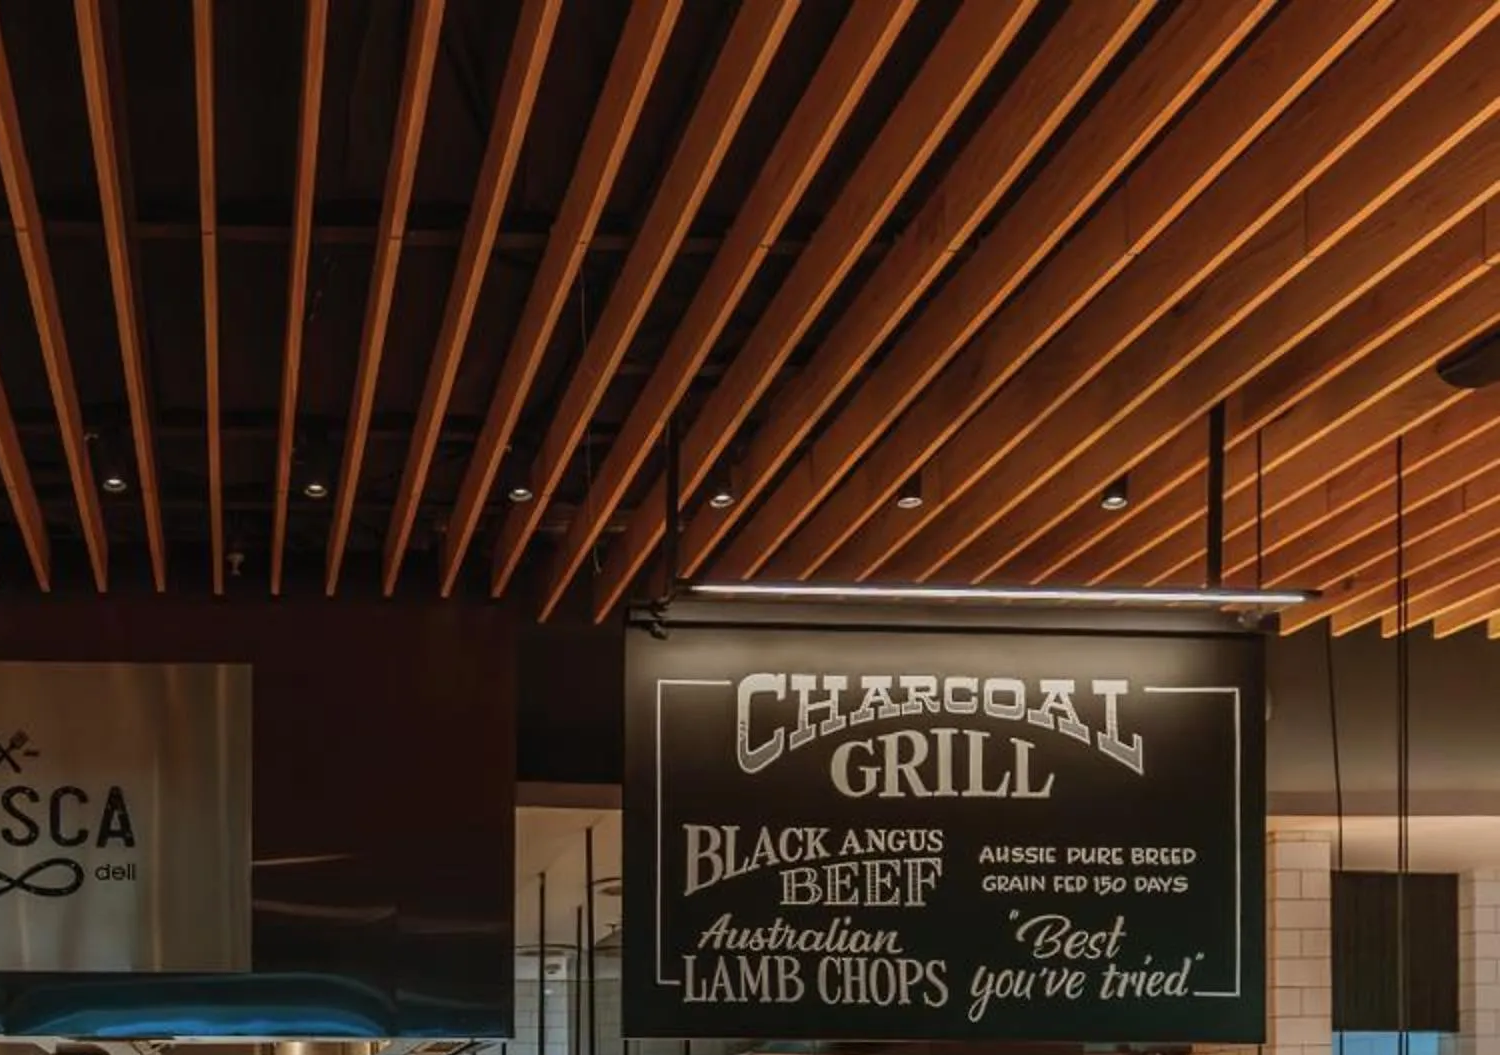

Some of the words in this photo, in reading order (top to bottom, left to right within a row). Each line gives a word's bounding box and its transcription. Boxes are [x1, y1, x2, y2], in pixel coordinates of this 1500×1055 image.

[736, 672, 1144, 776] CHARCOAL
[830, 728, 1055, 798] GRILL
[682, 823, 831, 897] BLACK
[839, 828, 944, 856] ANGUS
[979, 845, 1057, 865] AUSSIE
[1067, 847, 1125, 865] PURE
[1131, 847, 1197, 866] BREED
[779, 857, 944, 907] BEEF
[982, 875, 1045, 893] GRAIN
[1053, 875, 1088, 893] FED
[1094, 876, 1127, 896] 150
[1134, 876, 1189, 893] DAYS
[697, 912, 904, 954] Australian
[1009, 909, 1127, 960] "Best
[682, 955, 805, 1003] LAMB
[817, 956, 950, 1008] CHOPS
[968, 965, 1086, 1023] you've
[1100, 952, 1205, 1000] tried"
